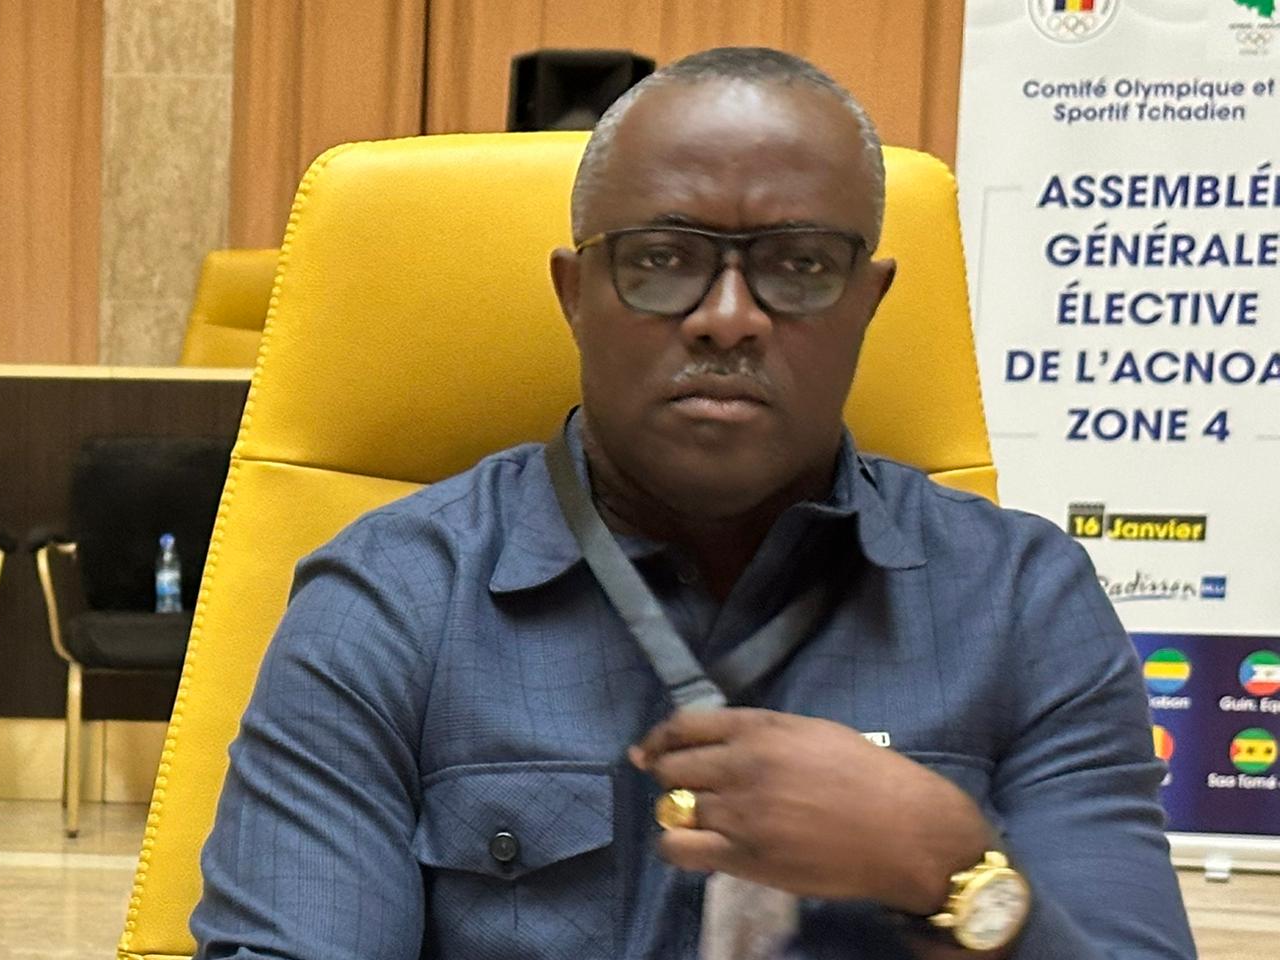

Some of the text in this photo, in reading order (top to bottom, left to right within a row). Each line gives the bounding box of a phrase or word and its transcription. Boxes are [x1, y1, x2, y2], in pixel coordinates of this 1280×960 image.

[1022, 78, 1276, 101] Comité Olympique et
[1053, 103, 1246, 124] Sportif Tchadien
[1045, 221, 1279, 267] GÉNÉRALE
[1057, 281, 1258, 326] ÉLECTIVE
[1005, 350, 1061, 383] DE
[1066, 408, 1230, 442] ZONE 4
[1074, 515, 1202, 540] 16 Janvier
